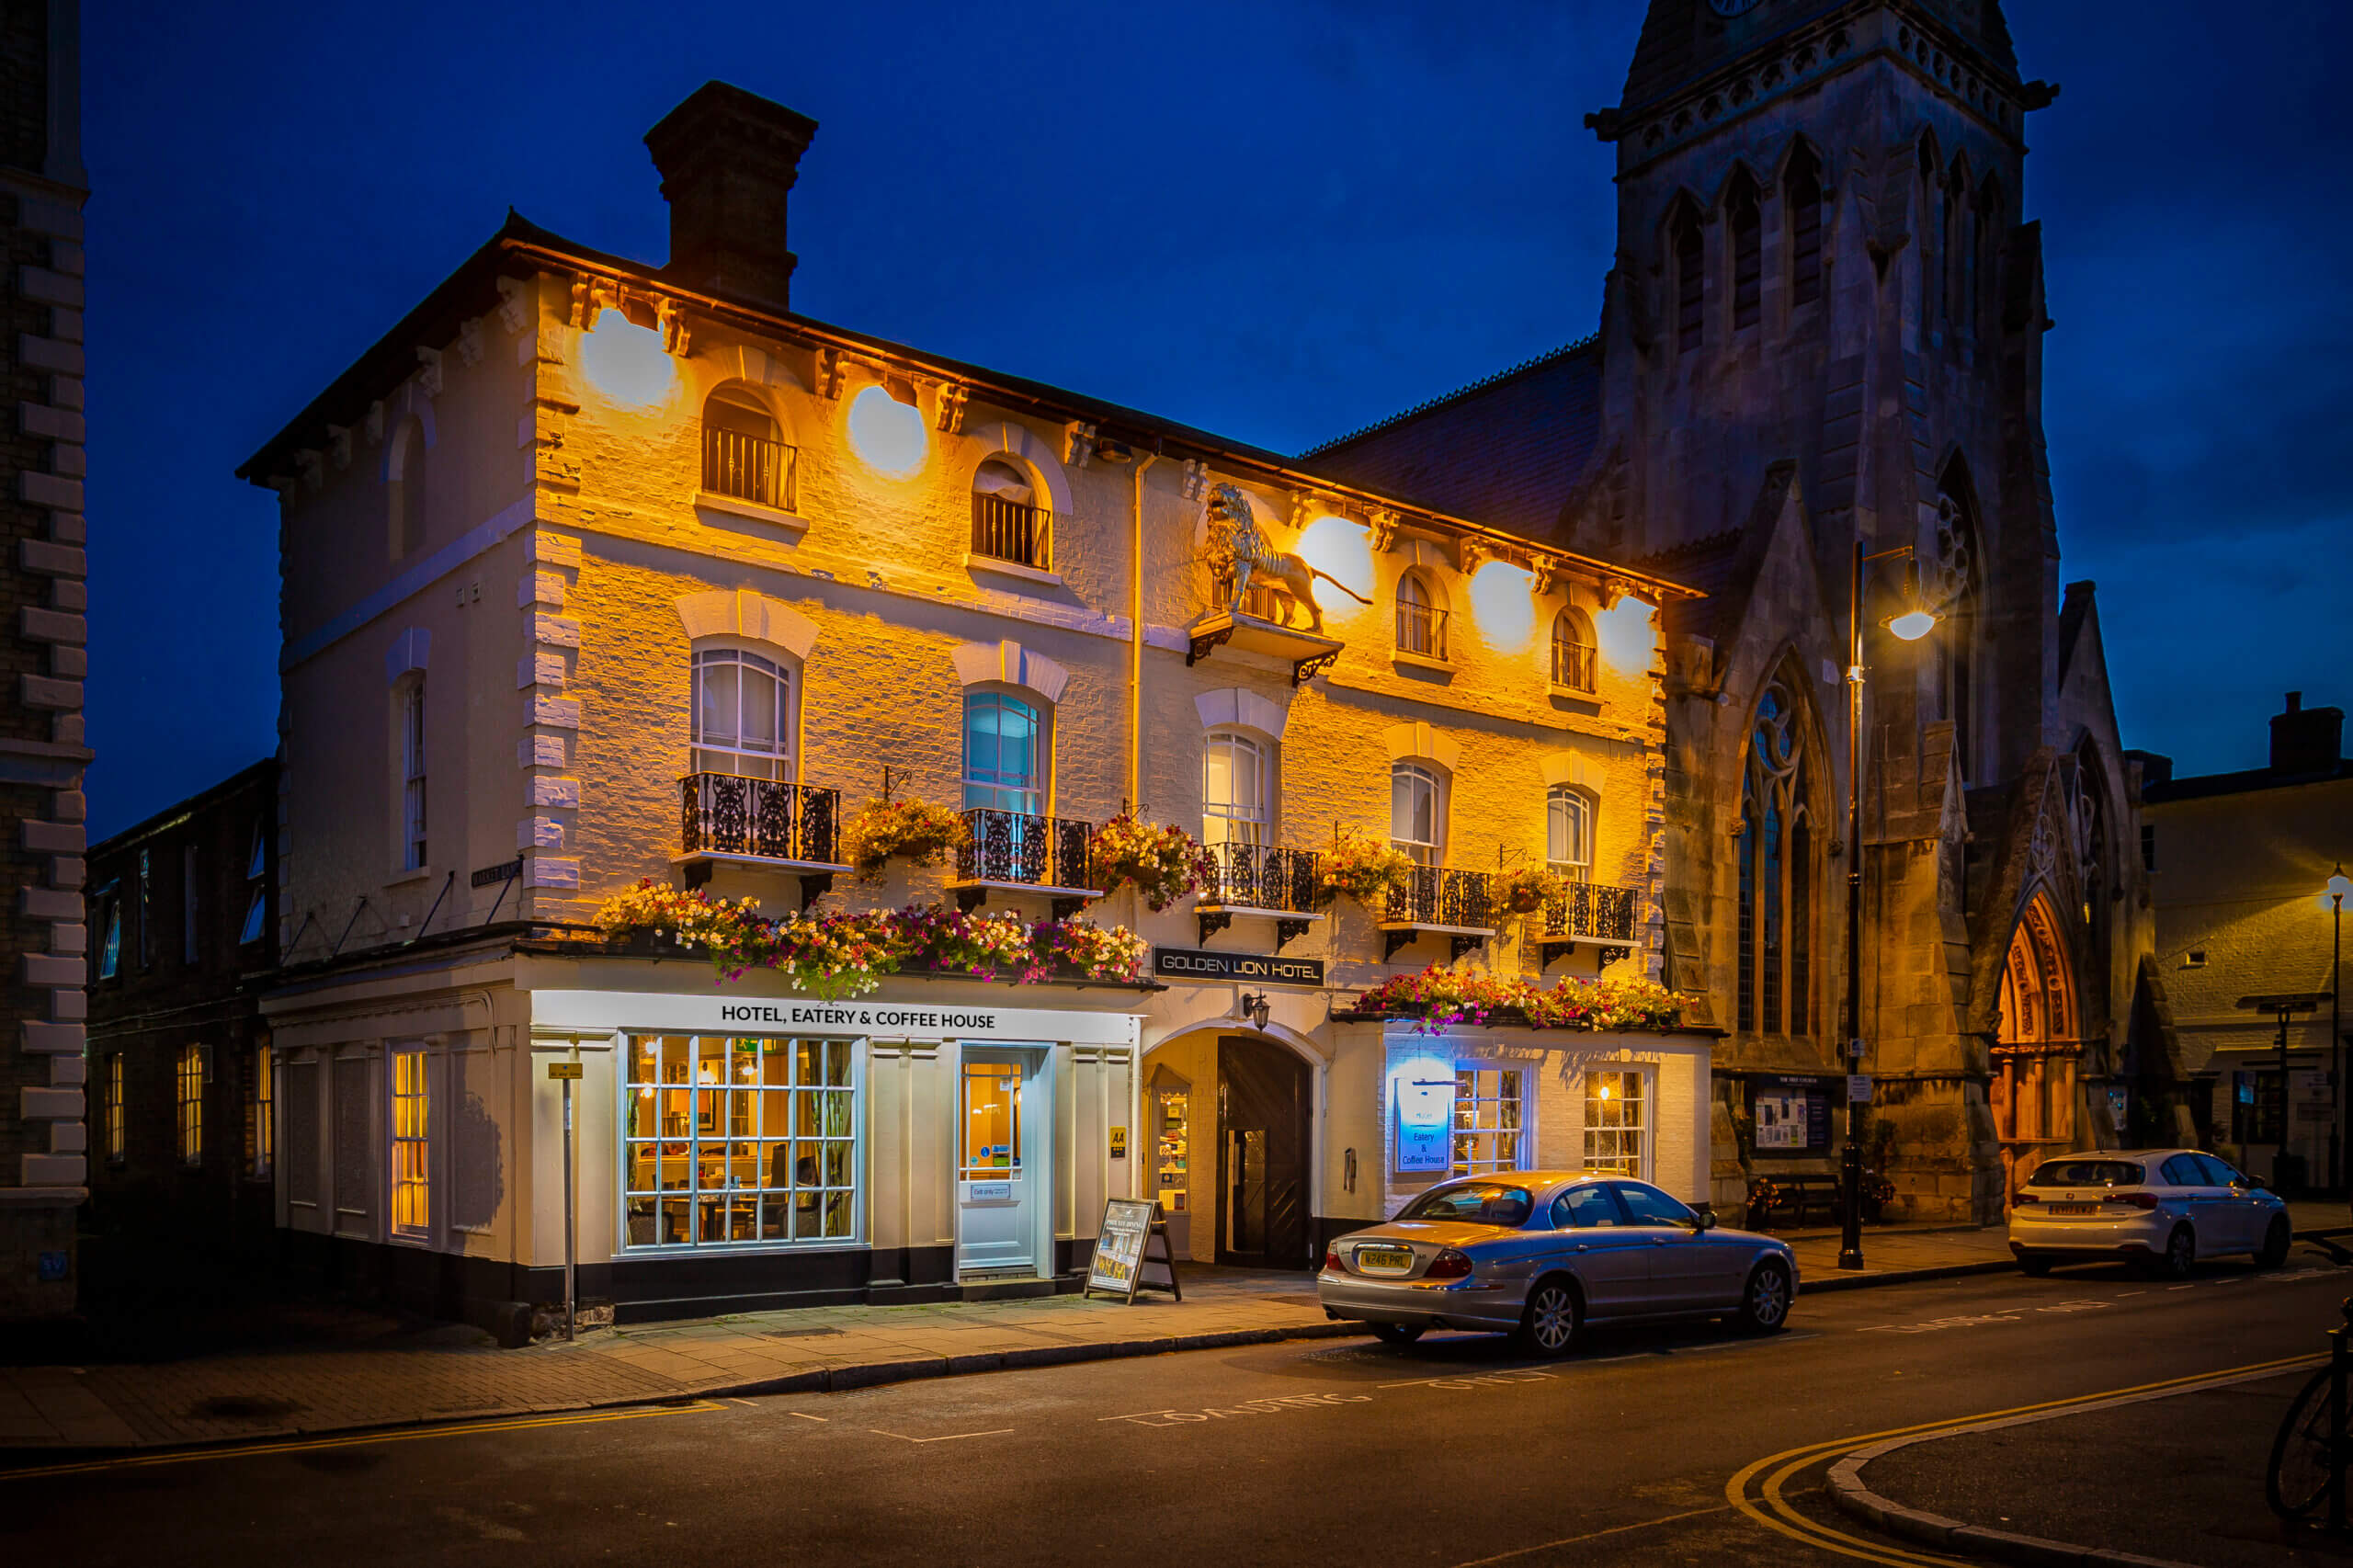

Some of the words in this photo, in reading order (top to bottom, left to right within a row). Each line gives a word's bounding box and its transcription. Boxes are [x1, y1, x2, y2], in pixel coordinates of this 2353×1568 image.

[1162, 955, 1229, 972] GOLDEN
[1233, 960, 1267, 975] LION
[1271, 963, 1320, 979] HOTEL
[722, 1006, 787, 1024] HOTEL,
[792, 1008, 856, 1024] EATERY
[859, 1011, 871, 1025] &
[876, 1011, 938, 1027] COFFEE
[941, 1014, 995, 1028] HOUSE
[1112, 1132, 1124, 1143] AA
[1414, 1132, 1435, 1142] Eatery
[1421, 1144, 1427, 1153] &
[1403, 1155, 1424, 1165] Coffee
[1426, 1155, 1445, 1165] House
[1124, 1392, 1373, 1426] LOADING
[1428, 1369, 1560, 1390] ONLY
